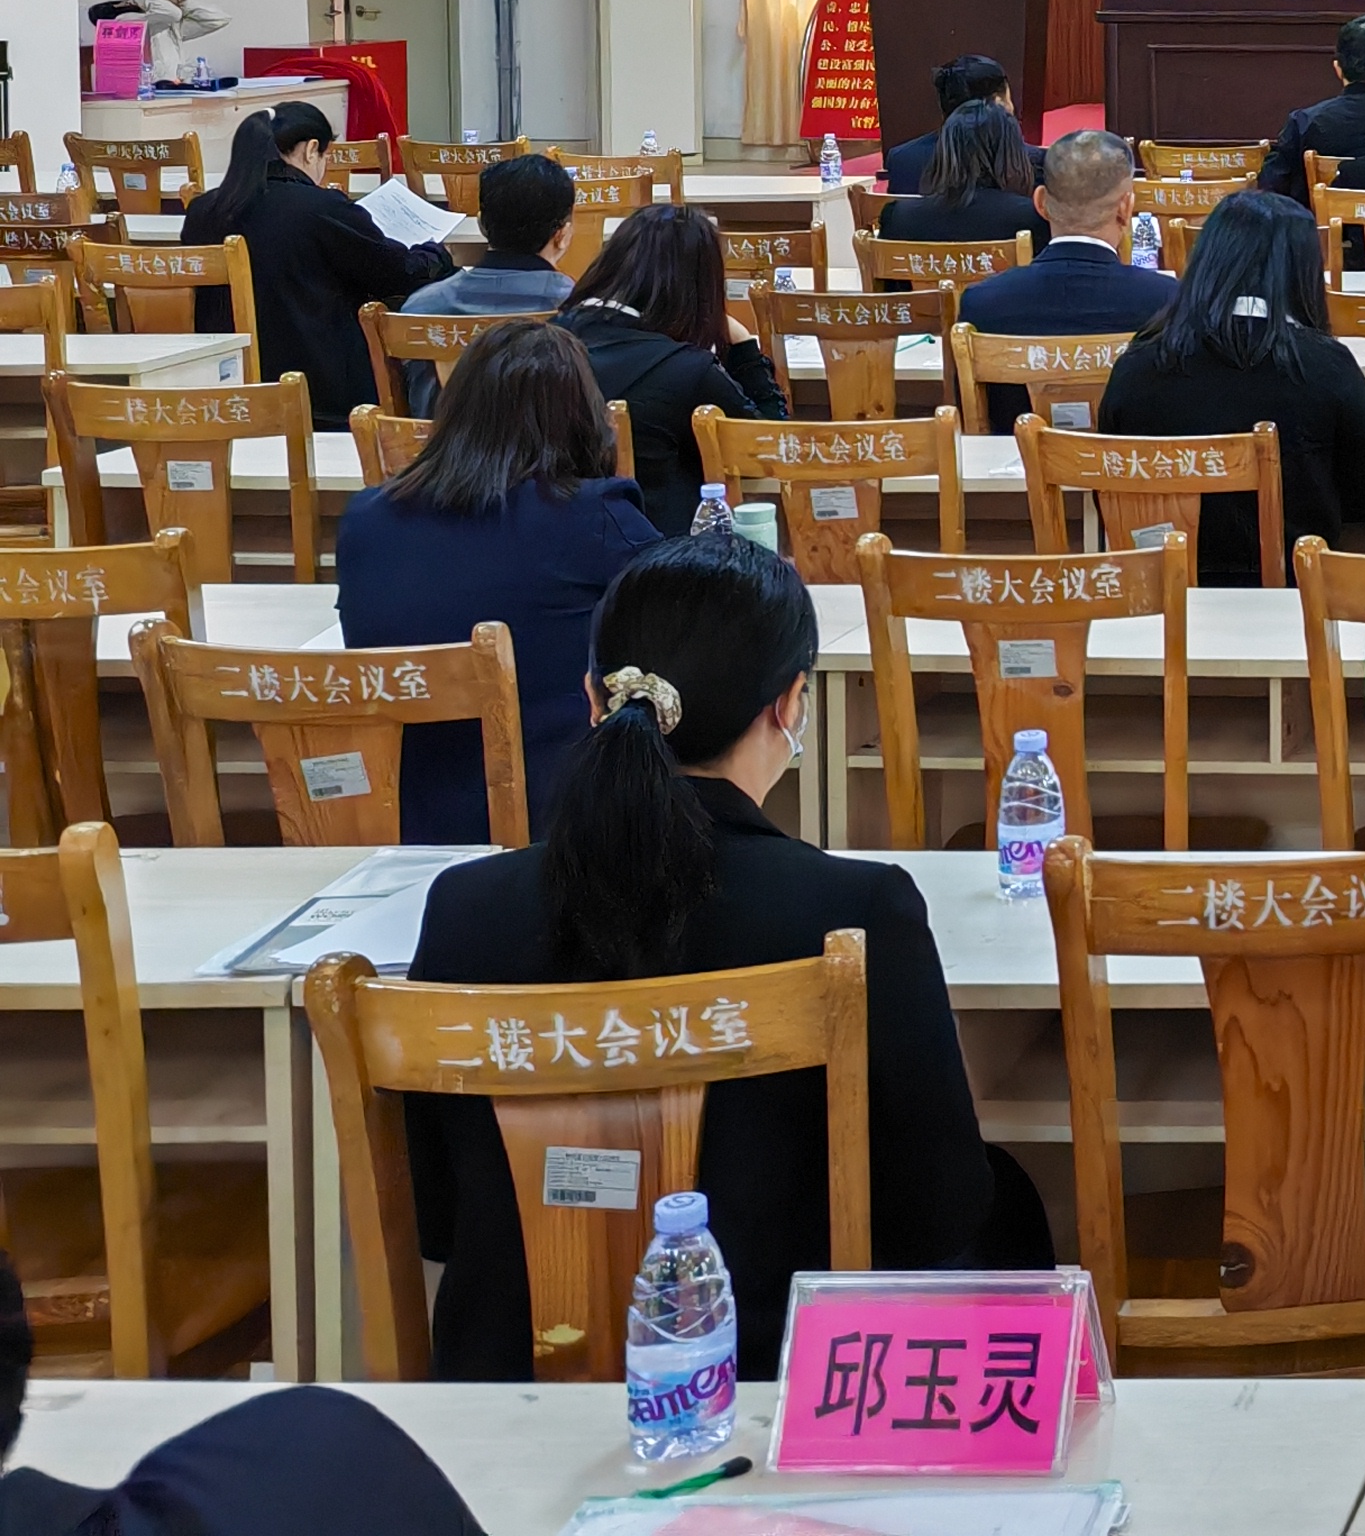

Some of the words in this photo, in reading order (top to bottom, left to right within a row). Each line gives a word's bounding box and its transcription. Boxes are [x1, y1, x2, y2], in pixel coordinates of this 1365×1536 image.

[1170, 152, 1247, 169] 二楼大会议室
[105, 254, 206, 276] 二楼大会议室
[892, 251, 995, 276] 二楼大会议室
[796, 302, 913, 326] 二楼大会议室
[101, 394, 252, 426] 二楼大会议室
[755, 430, 906, 465] 二楼大会议室
[1076, 447, 1229, 480] 二楼大会议室
[933, 563, 1124, 605] 二楼大会议室
[219, 661, 432, 706] 二楼大会议室
[436, 996, 754, 1073] 二楼大会议室
[813, 1330, 1044, 1437] 邱玉灵
